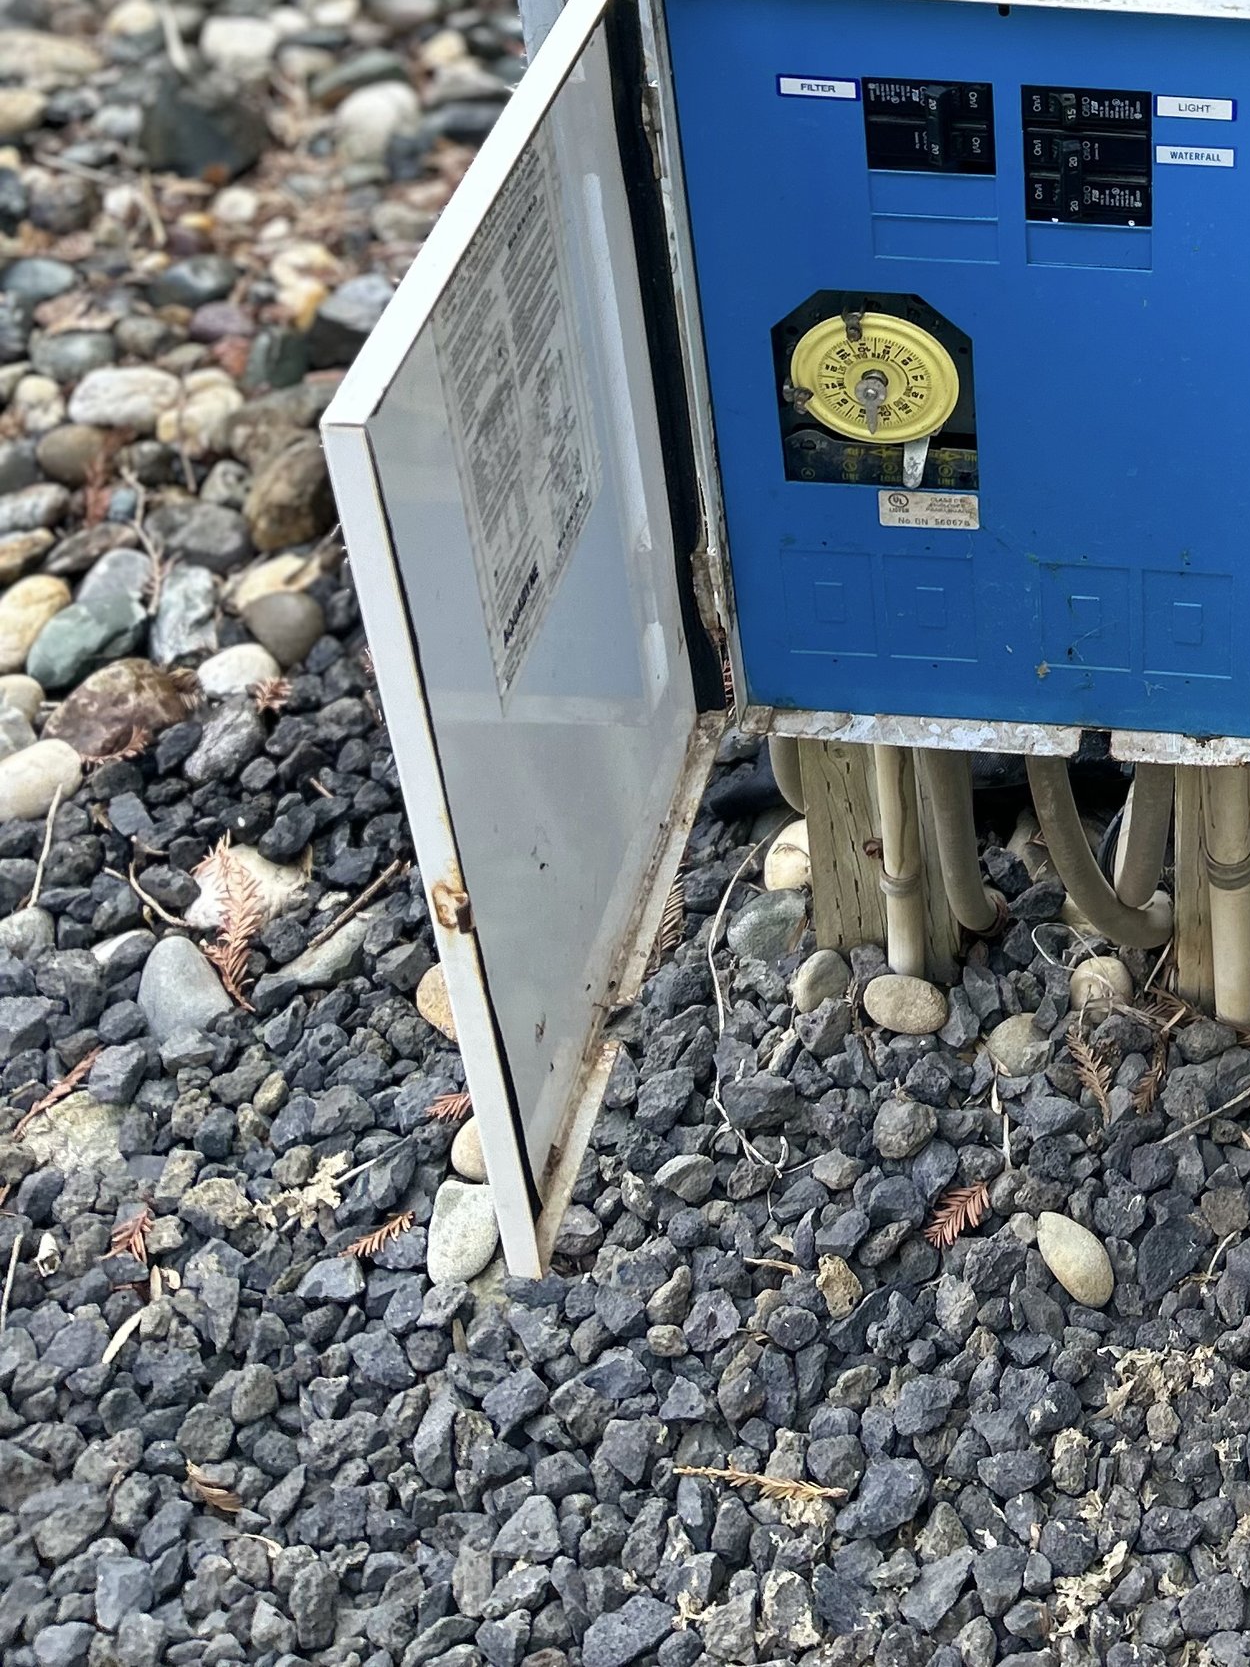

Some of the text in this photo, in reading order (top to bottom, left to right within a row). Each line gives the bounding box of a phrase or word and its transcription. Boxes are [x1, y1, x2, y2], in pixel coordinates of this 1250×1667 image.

[800, 82, 836, 93] FILTER
[928, 98, 937, 110] 20
[1178, 103, 1211, 113] LIGHT
[1067, 108, 1077, 120] 15
[931, 143, 940, 155] 20
[1068, 156, 1078, 168] 20
[1169, 151, 1222, 162] WATERFALL
[1070, 200, 1079, 212] 20
